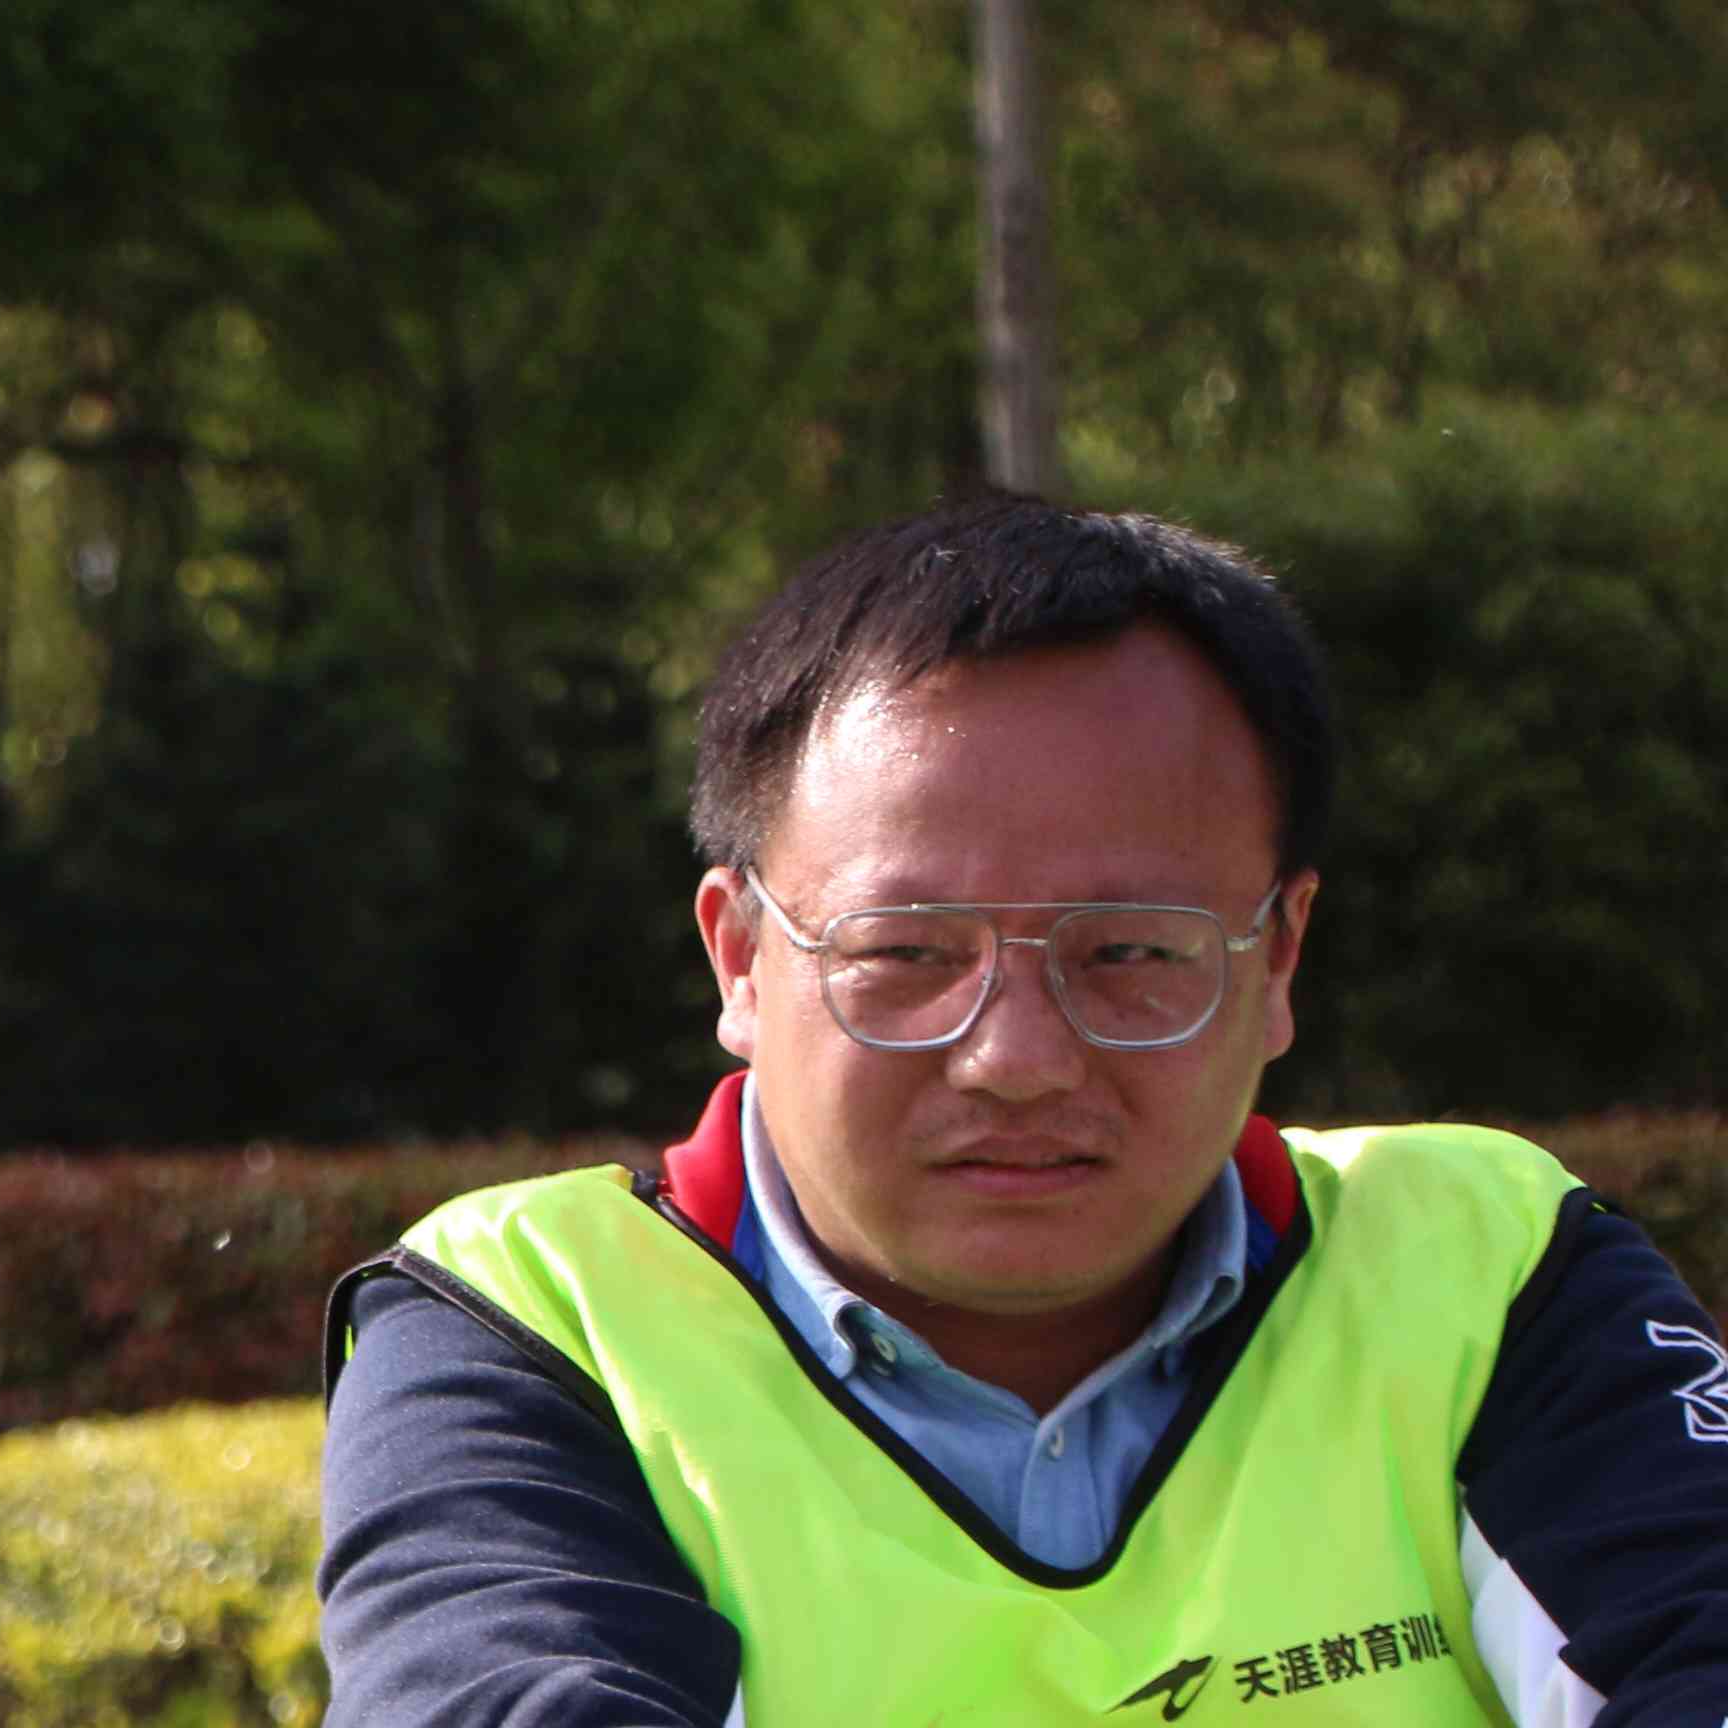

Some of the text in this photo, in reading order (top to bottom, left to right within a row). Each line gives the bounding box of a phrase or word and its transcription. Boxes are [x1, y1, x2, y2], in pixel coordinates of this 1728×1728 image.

[1233, 1613, 1452, 1703] 天涯教育训
